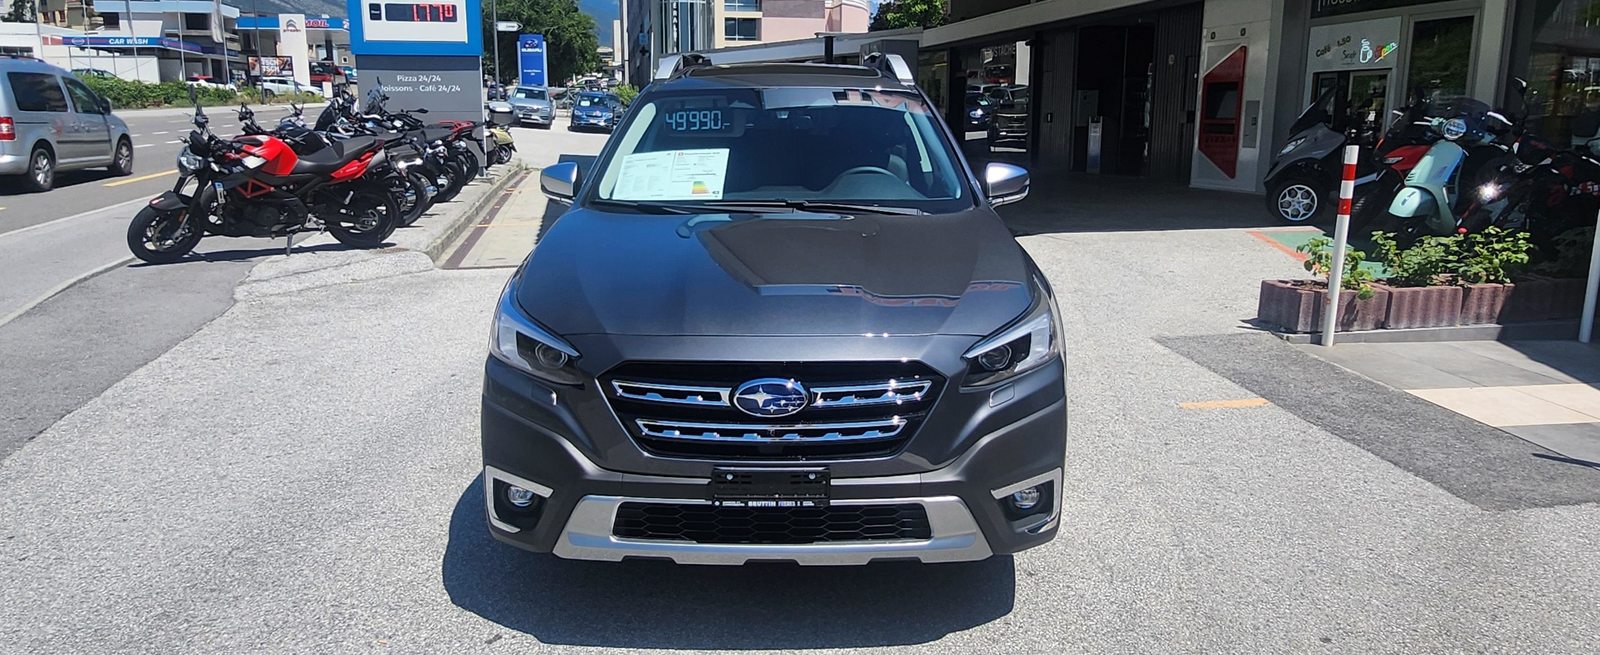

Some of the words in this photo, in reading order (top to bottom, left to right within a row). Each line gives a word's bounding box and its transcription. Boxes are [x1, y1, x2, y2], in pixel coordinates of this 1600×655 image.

[418, 75, 442, 83] 24/24
[420, 84, 437, 92] Café
[438, 85, 461, 93] 24/24
